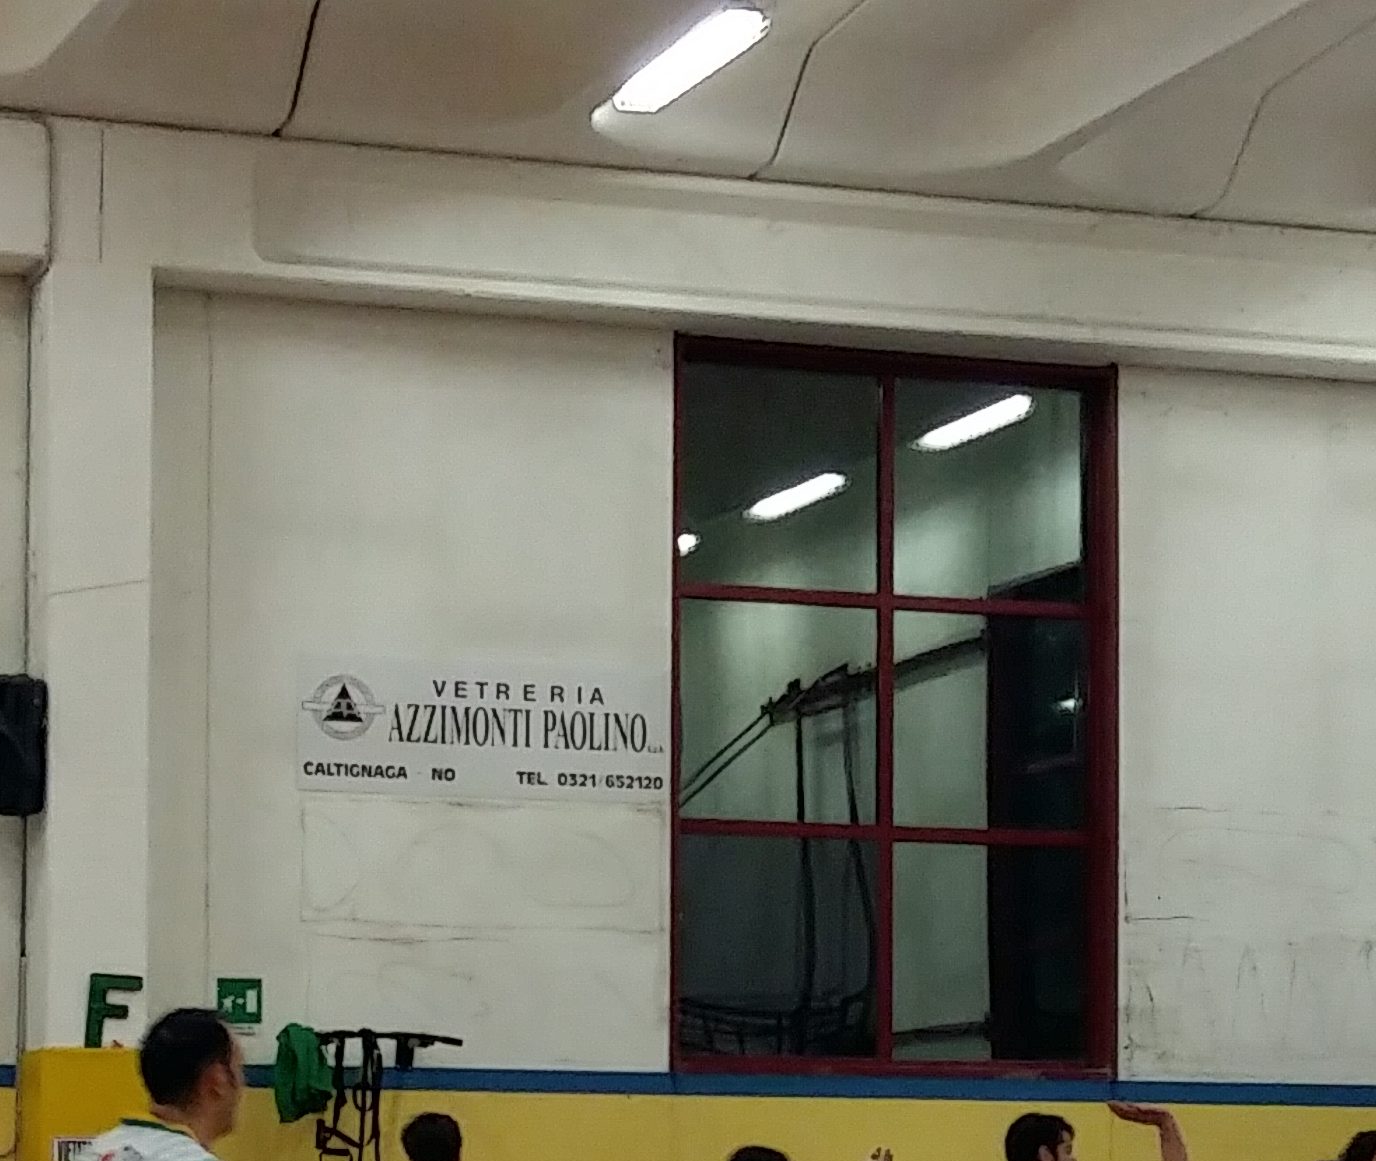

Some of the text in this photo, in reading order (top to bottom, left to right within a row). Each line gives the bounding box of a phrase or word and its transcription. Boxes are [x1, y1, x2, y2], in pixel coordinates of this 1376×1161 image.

[433, 680, 604, 705] VETRERIA
[388, 703, 647, 753] AZZIMONTI PAOLINO
[303, 761, 408, 779] CALTIGNAGA
[431, 768, 456, 781] NO
